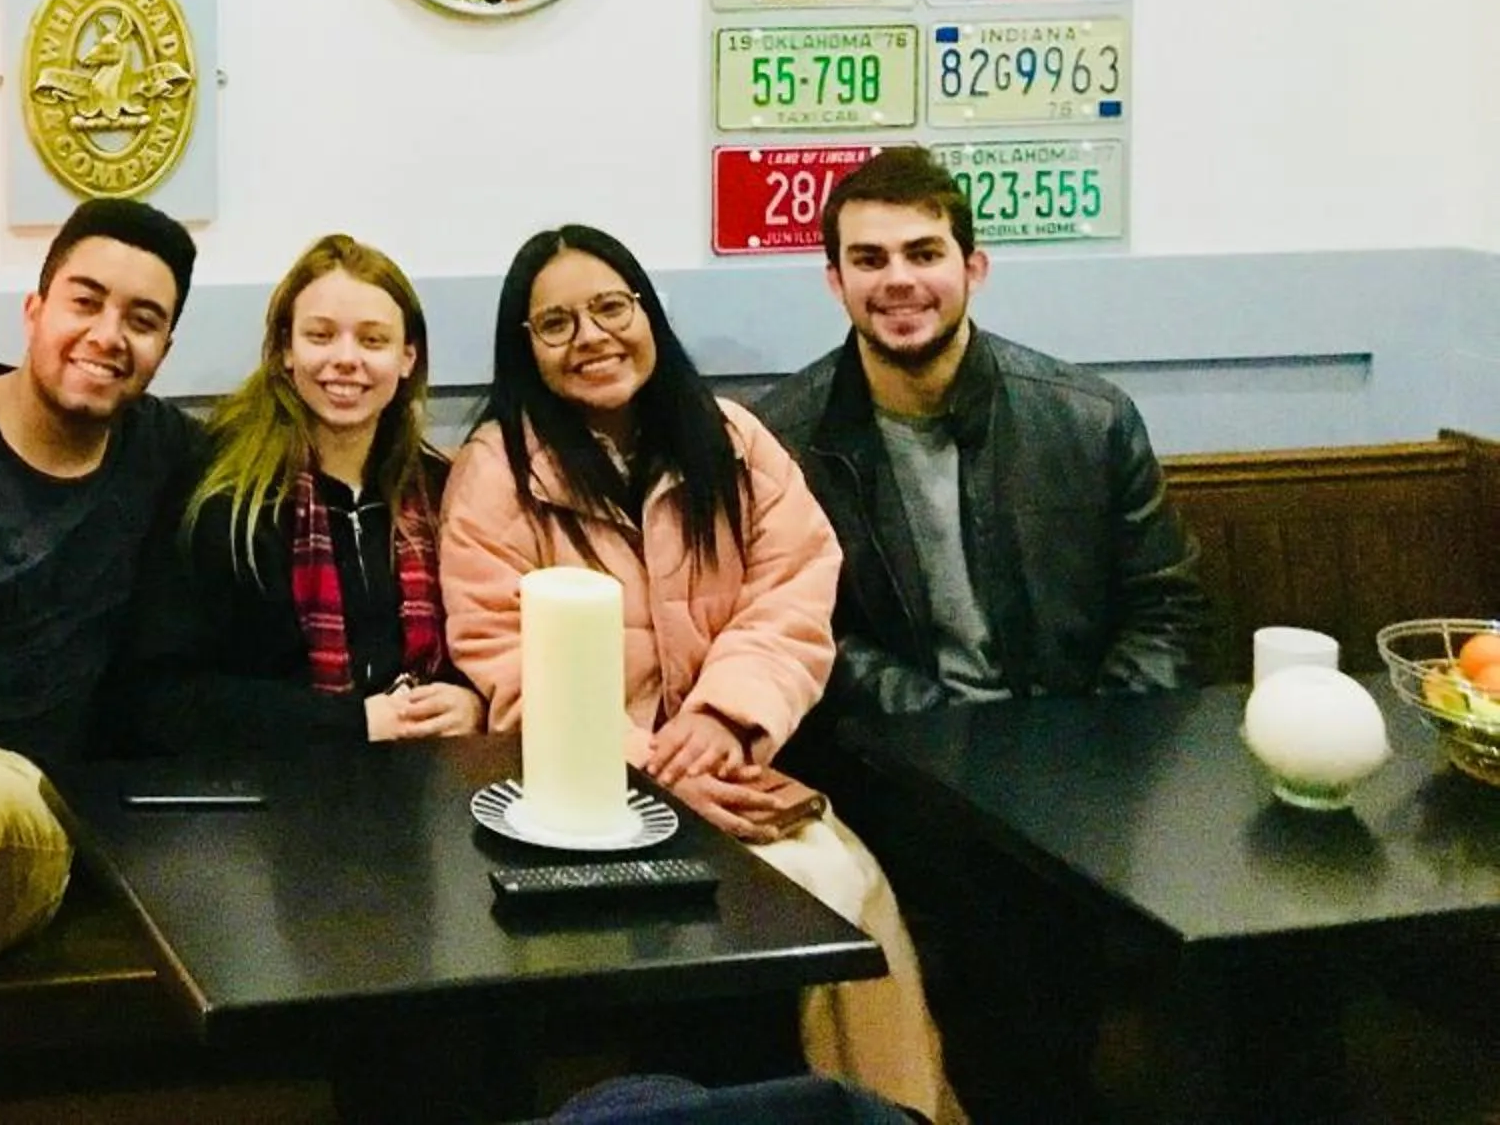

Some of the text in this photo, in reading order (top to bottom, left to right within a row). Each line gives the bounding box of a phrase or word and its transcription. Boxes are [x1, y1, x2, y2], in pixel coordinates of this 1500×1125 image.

[728, 36, 752, 51] 19
[763, 34, 872, 49] OKLAHOMA
[980, 27, 1077, 44] INDIANA
[753, 55, 880, 106] 55-798
[941, 46, 1119, 97] 82G9963
[56, 102, 181, 187] COMPANY
[972, 148, 1078, 165] OKLAHOMA
